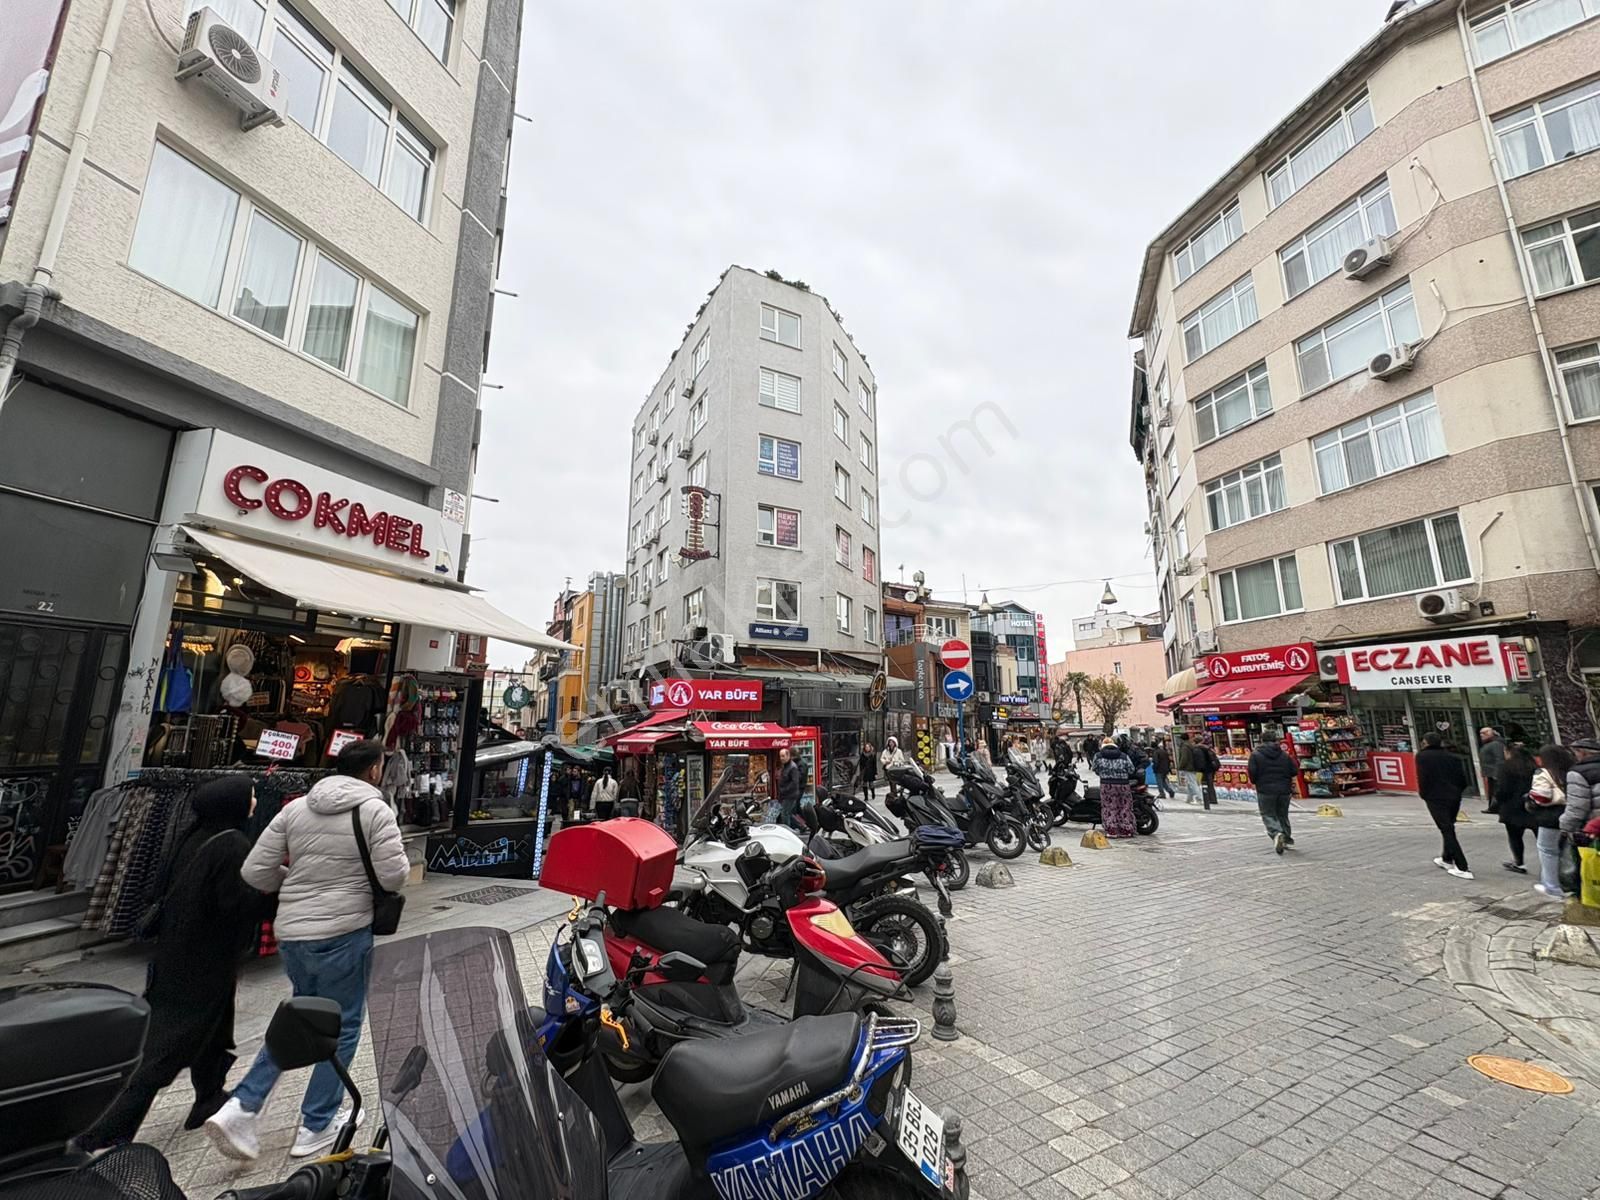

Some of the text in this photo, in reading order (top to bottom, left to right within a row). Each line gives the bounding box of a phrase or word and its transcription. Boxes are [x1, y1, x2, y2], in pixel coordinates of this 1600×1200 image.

[223, 464, 430, 558] ÇOKMEL
[1231, 659, 1286, 674] KURUYEMİŞ
[1240, 652, 1270, 662] FATOŞ
[1352, 640, 1493, 672] ECZANE
[1390, 675, 1453, 685] CANSEVER
[698, 689, 723, 700] YAR
[725, 688, 758, 701] BÜFE
[709, 739, 749, 748] YAR BÜFE
[1379, 760, 1401, 781] E
[767, 1080, 810, 1111] YAMAHA
[903, 1092, 922, 1158] 35 BGJ
[710, 1112, 874, 1200] YAMAHA
[922, 1124, 938, 1167] 028
